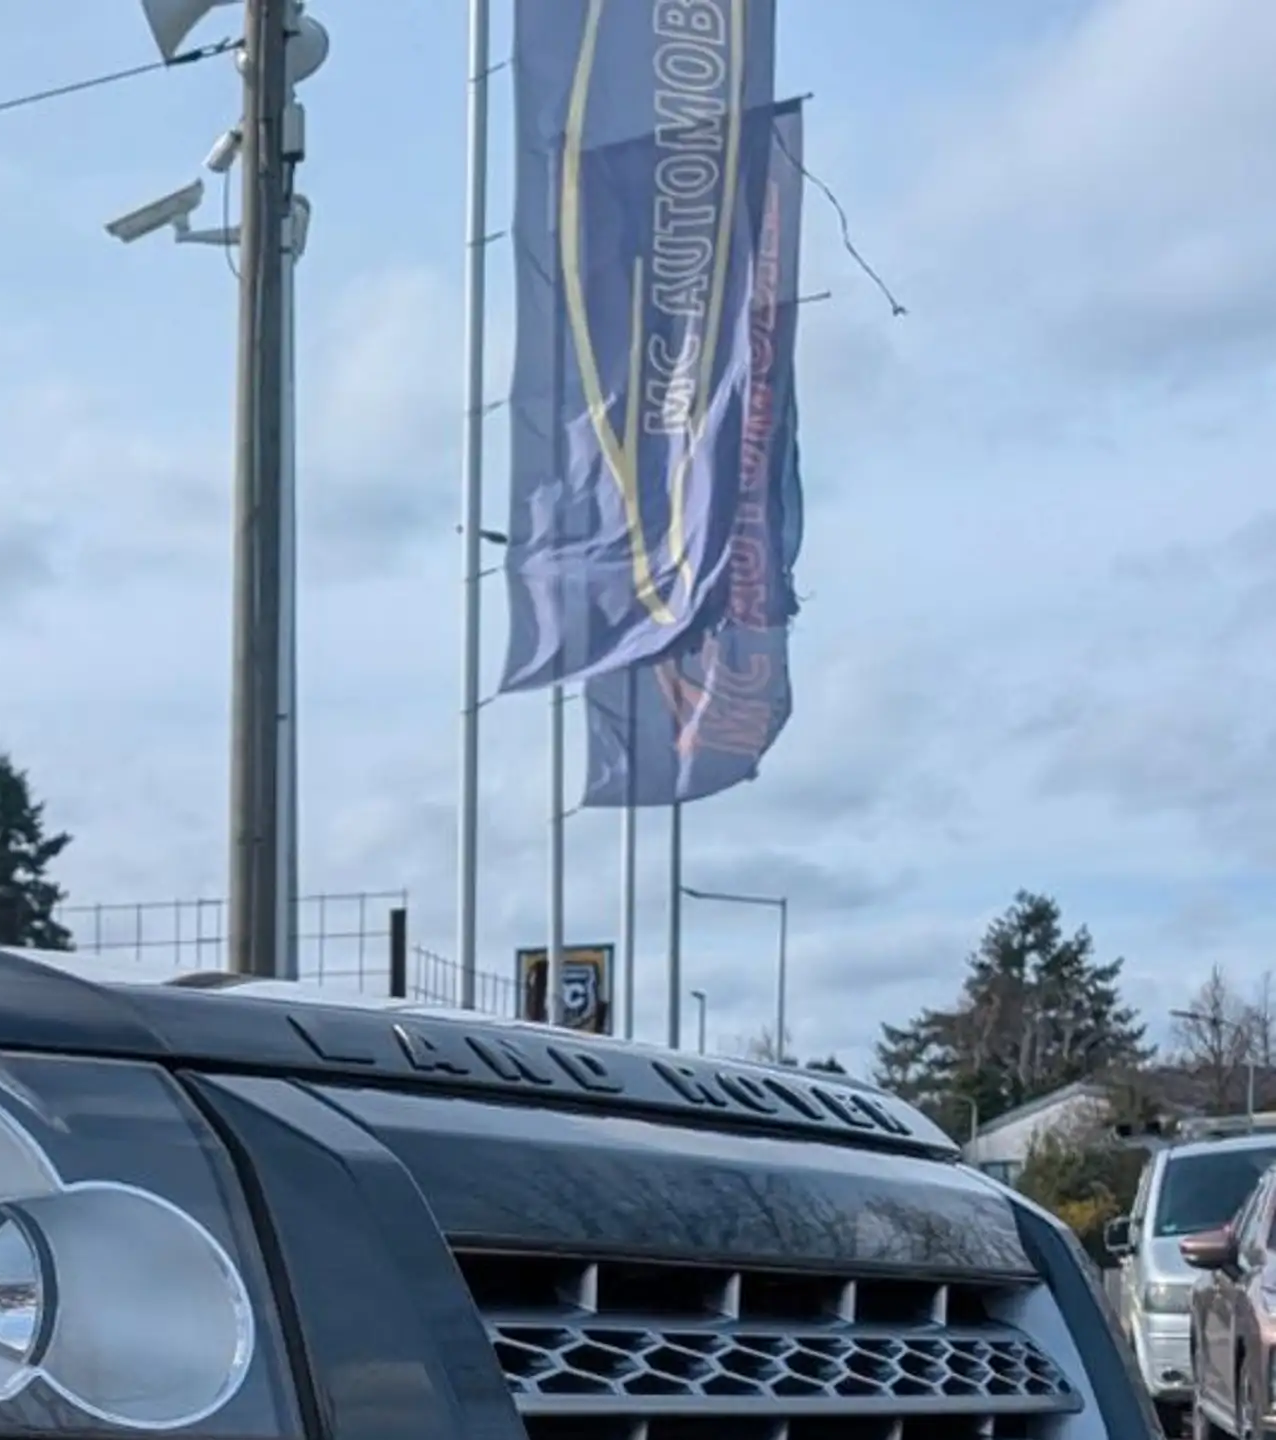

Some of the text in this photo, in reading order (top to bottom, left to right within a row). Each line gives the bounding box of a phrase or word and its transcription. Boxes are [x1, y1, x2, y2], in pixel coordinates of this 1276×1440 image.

[645, 333, 701, 436] MC
[286, 1014, 913, 1136] LAND ROVER
